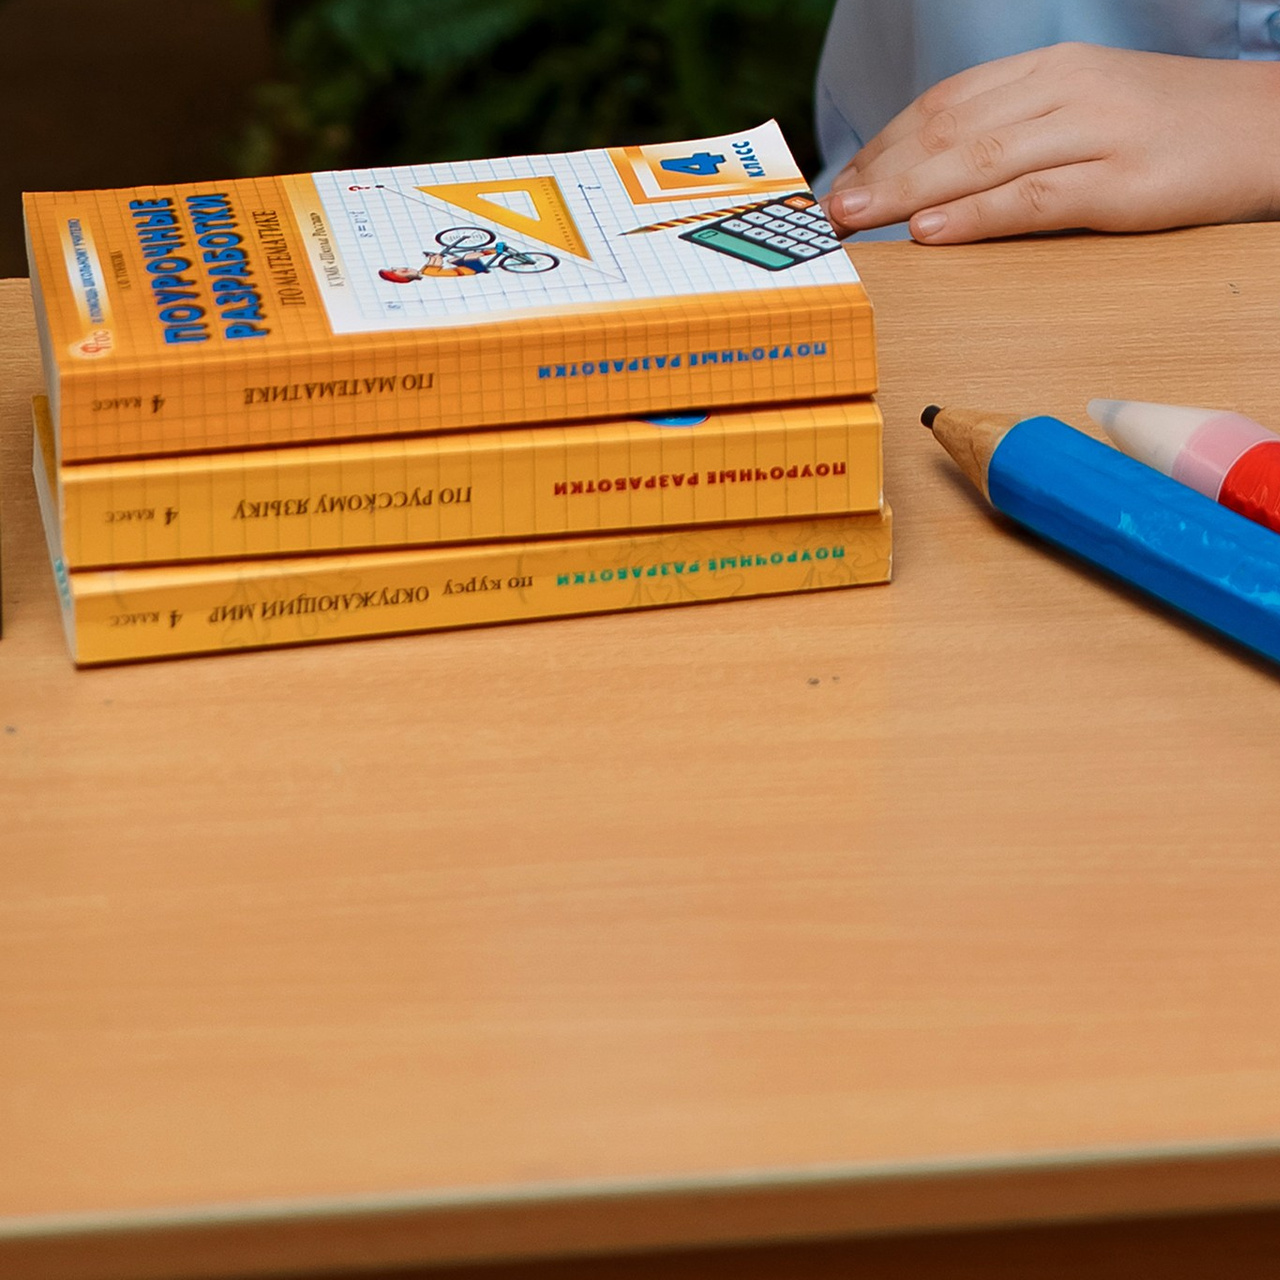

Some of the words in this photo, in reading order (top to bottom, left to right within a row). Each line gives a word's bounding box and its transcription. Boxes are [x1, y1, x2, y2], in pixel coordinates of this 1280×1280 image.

[660, 152, 726, 175] 4
[732, 140, 766, 177] КЛАСС
[252, 209, 300, 286] МАТЕМАТИКЕ
[129, 198, 211, 344] ПОУРОЧНЫЕ
[186, 193, 268, 339] РАЗРАБОТКИ
[278, 288, 306, 306] ПО
[689, 342, 827, 366] ПОУРОЧНЫЕ
[538, 355, 682, 379] РАЗРАБОТКИ
[244, 375, 398, 405] МАТЕМАТИКЕ
[401, 372, 434, 391] ПО
[151, 394, 167, 413] 4
[554, 472, 699, 496] РАЗРАБОТКИ
[706, 461, 847, 485] ПОУРОЧНЫЕ
[314, 487, 435, 515] РУССКОМУ
[438, 486, 473, 506] ПО
[164, 506, 180, 526] 4
[232, 498, 310, 521] ЯЗЫКУ
[708, 545, 845, 570] ПОУРОЧНЫЕ
[442, 577, 502, 596] курсу
[507, 575, 534, 589] по
[556, 563, 699, 586] РАЗРАБОТКИ
[208, 601, 257, 624] МИР
[261, 585, 430, 620] ОКРУЖАЮЩИЙ
[168, 609, 184, 629] 4
